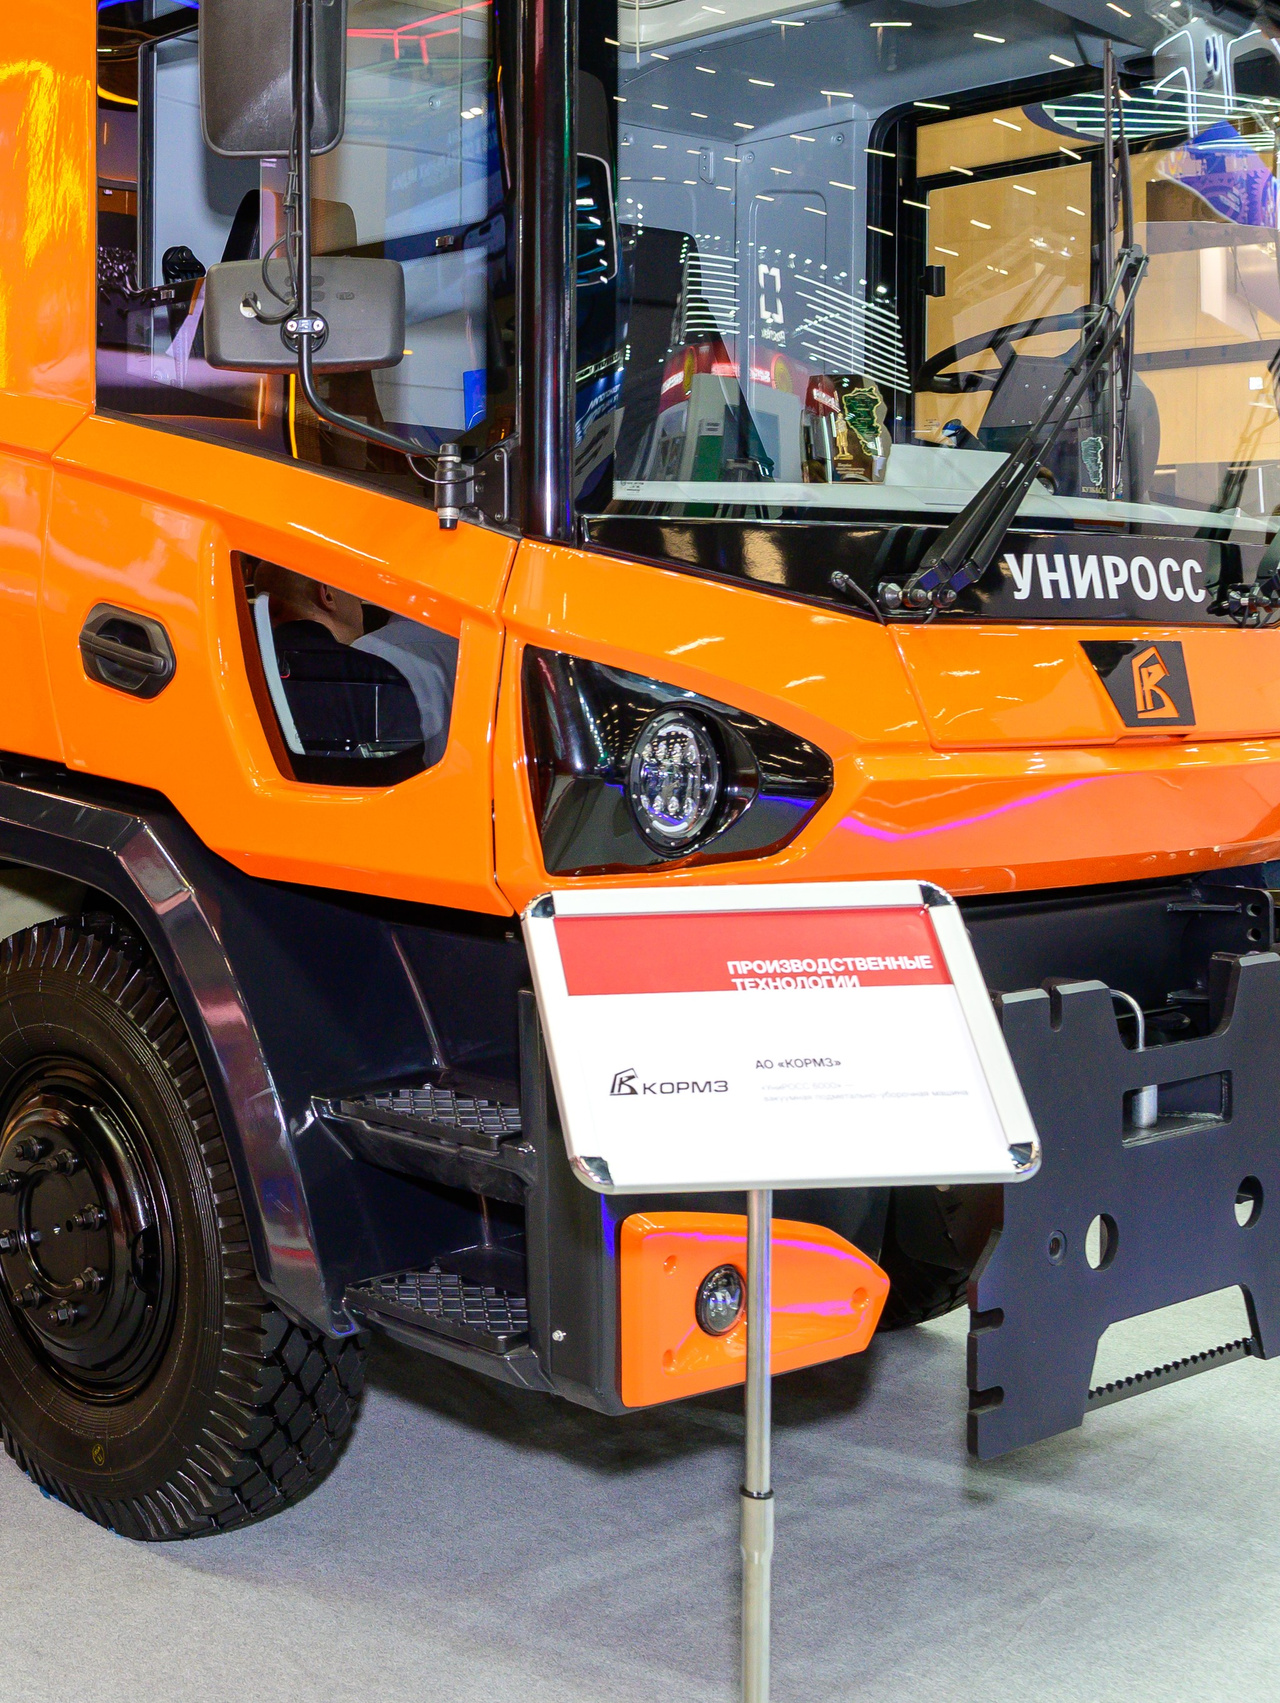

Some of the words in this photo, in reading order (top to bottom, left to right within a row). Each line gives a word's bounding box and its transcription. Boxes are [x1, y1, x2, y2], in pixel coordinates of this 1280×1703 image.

[1004, 553, 1206, 603] УНИРОСС
[727, 955, 934, 975] ПРОИЗВОДСТВЕННЫЕ
[731, 975, 860, 991] ТЕХНОЛОГИИ
[755, 1059, 774, 1070] АО
[777, 1057, 842, 1069] «КОРМЗ»
[643, 1080, 729, 1095] КОРМЗ
